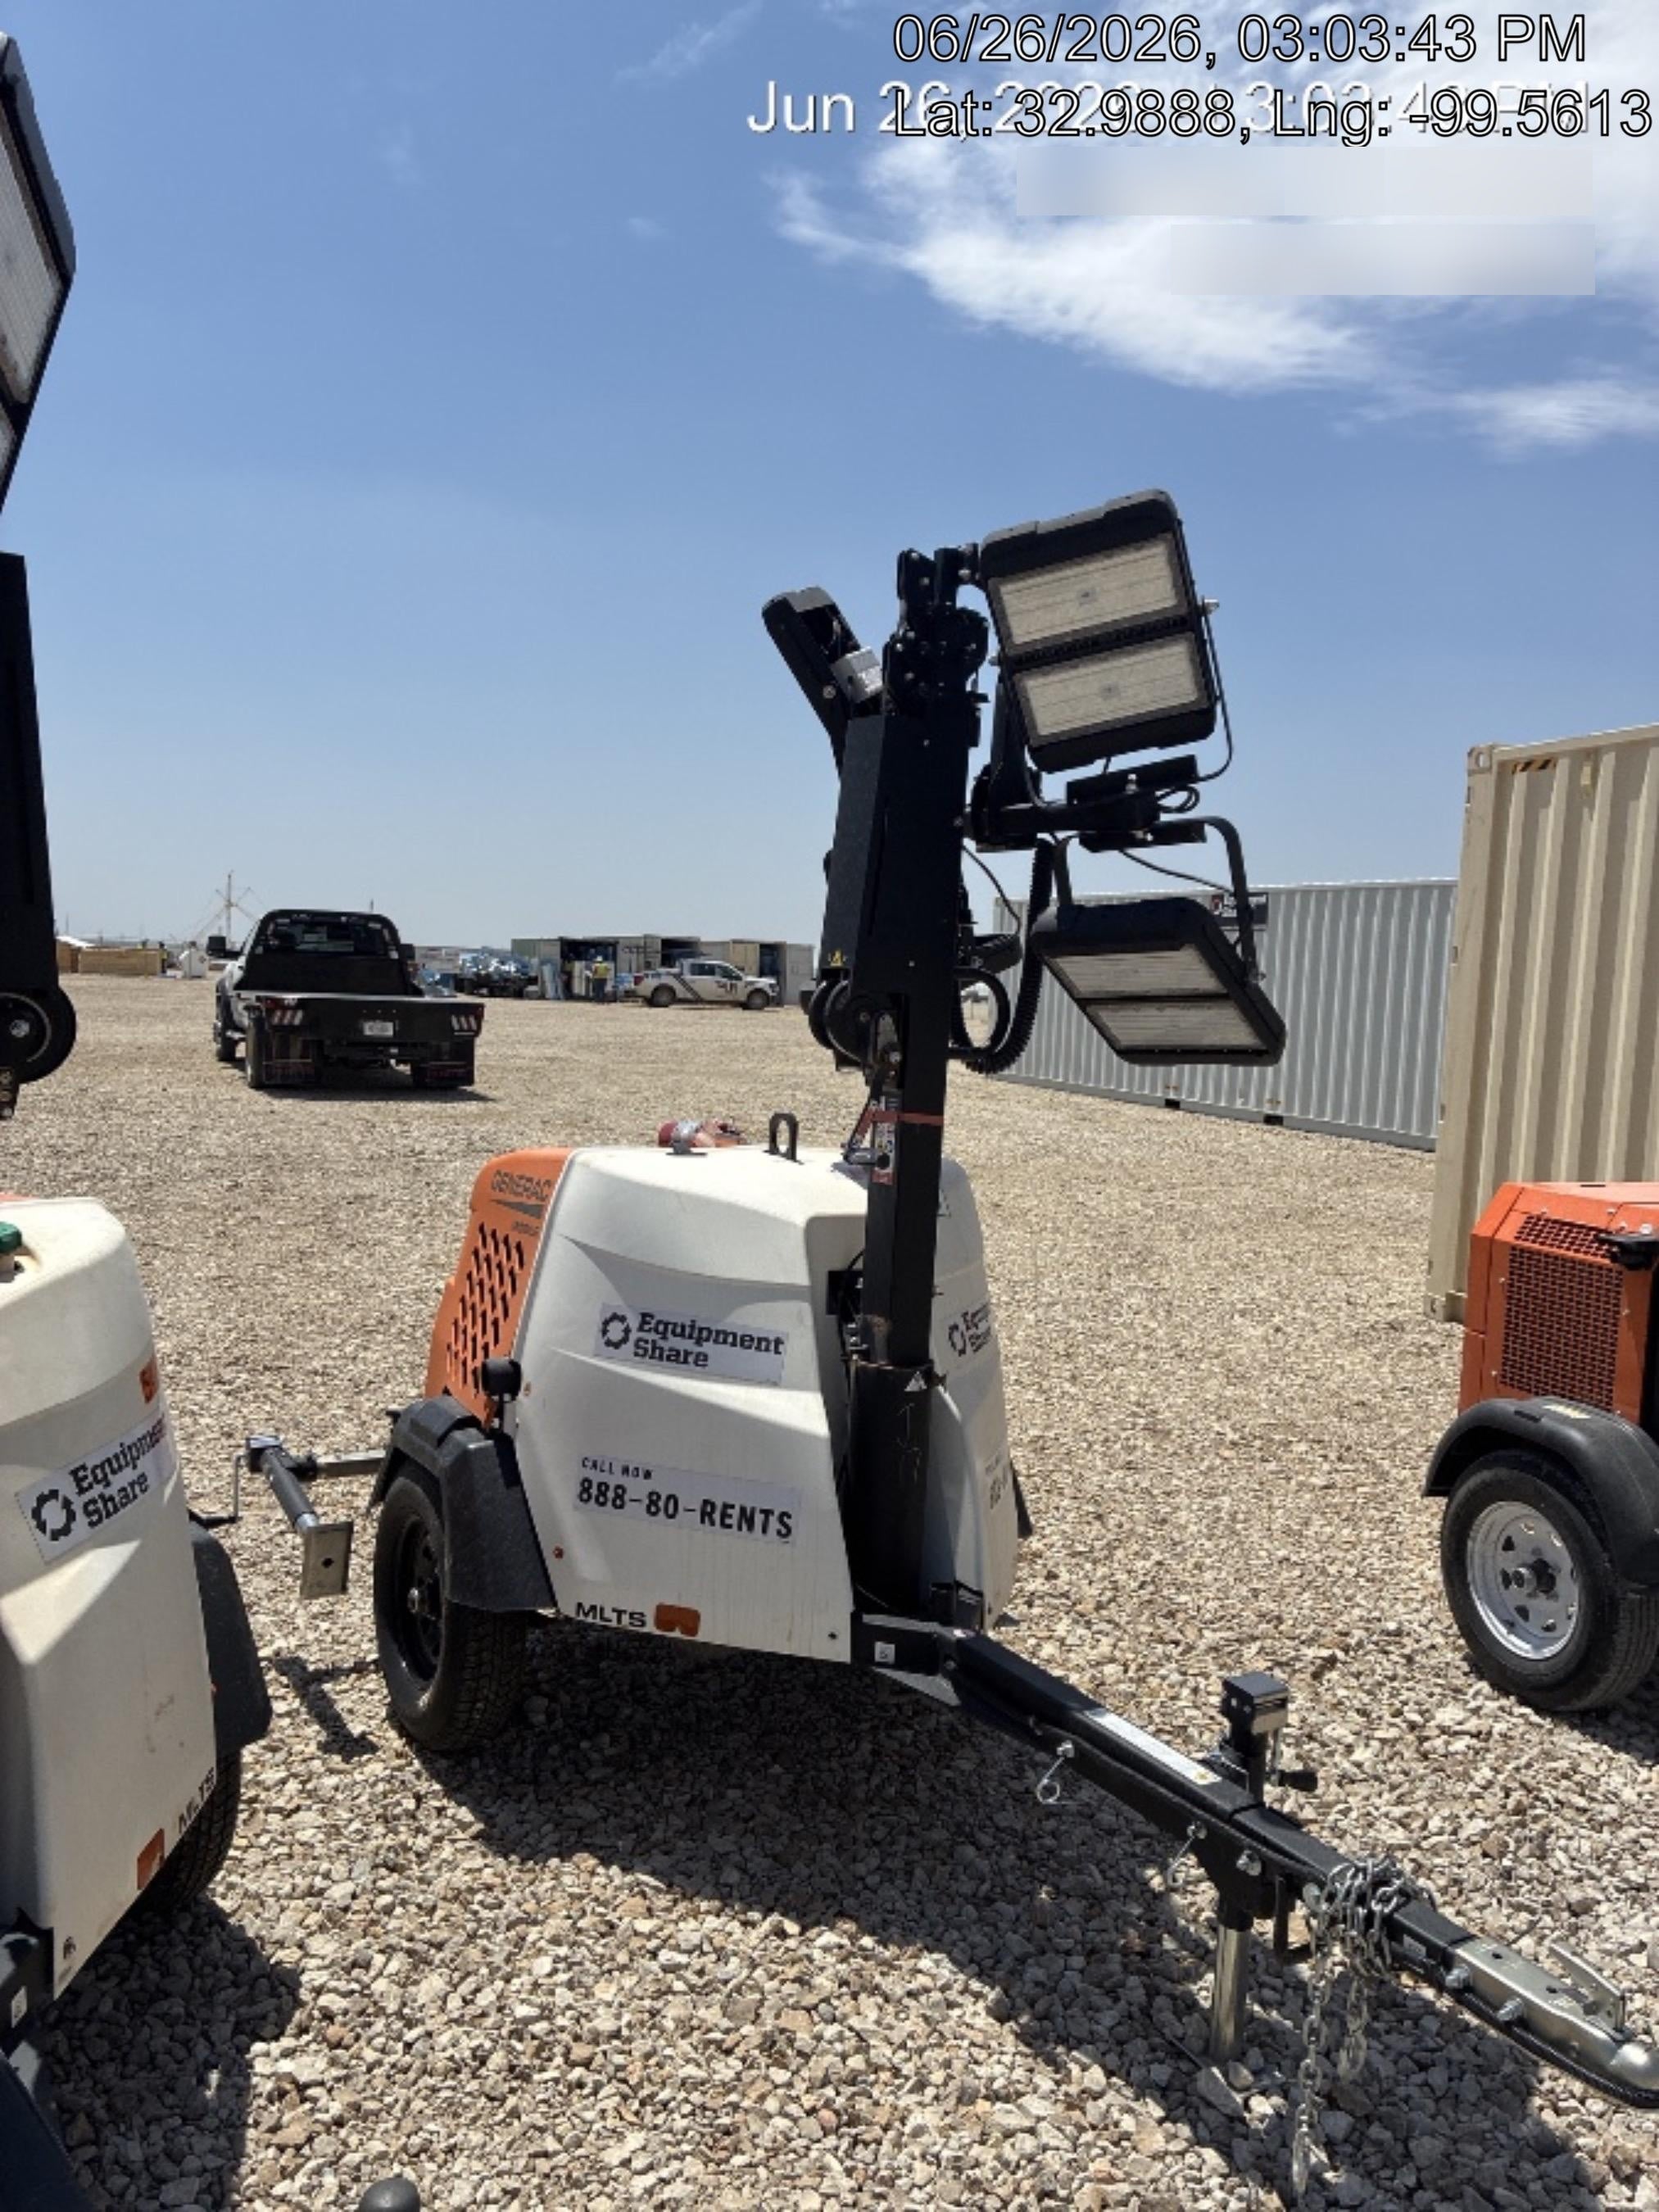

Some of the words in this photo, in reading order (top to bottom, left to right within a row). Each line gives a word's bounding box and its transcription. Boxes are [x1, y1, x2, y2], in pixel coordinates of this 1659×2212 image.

[637, 1312, 785, 1355] Equipment
[633, 1337, 709, 1367] Share
[582, 1457, 614, 1475] CALL
[621, 1465, 654, 1480] NOW
[83, 1472, 149, 1530] Share
[578, 1477, 793, 1539] 888-80-RENTS
[576, 1602, 647, 1628] MLTS
